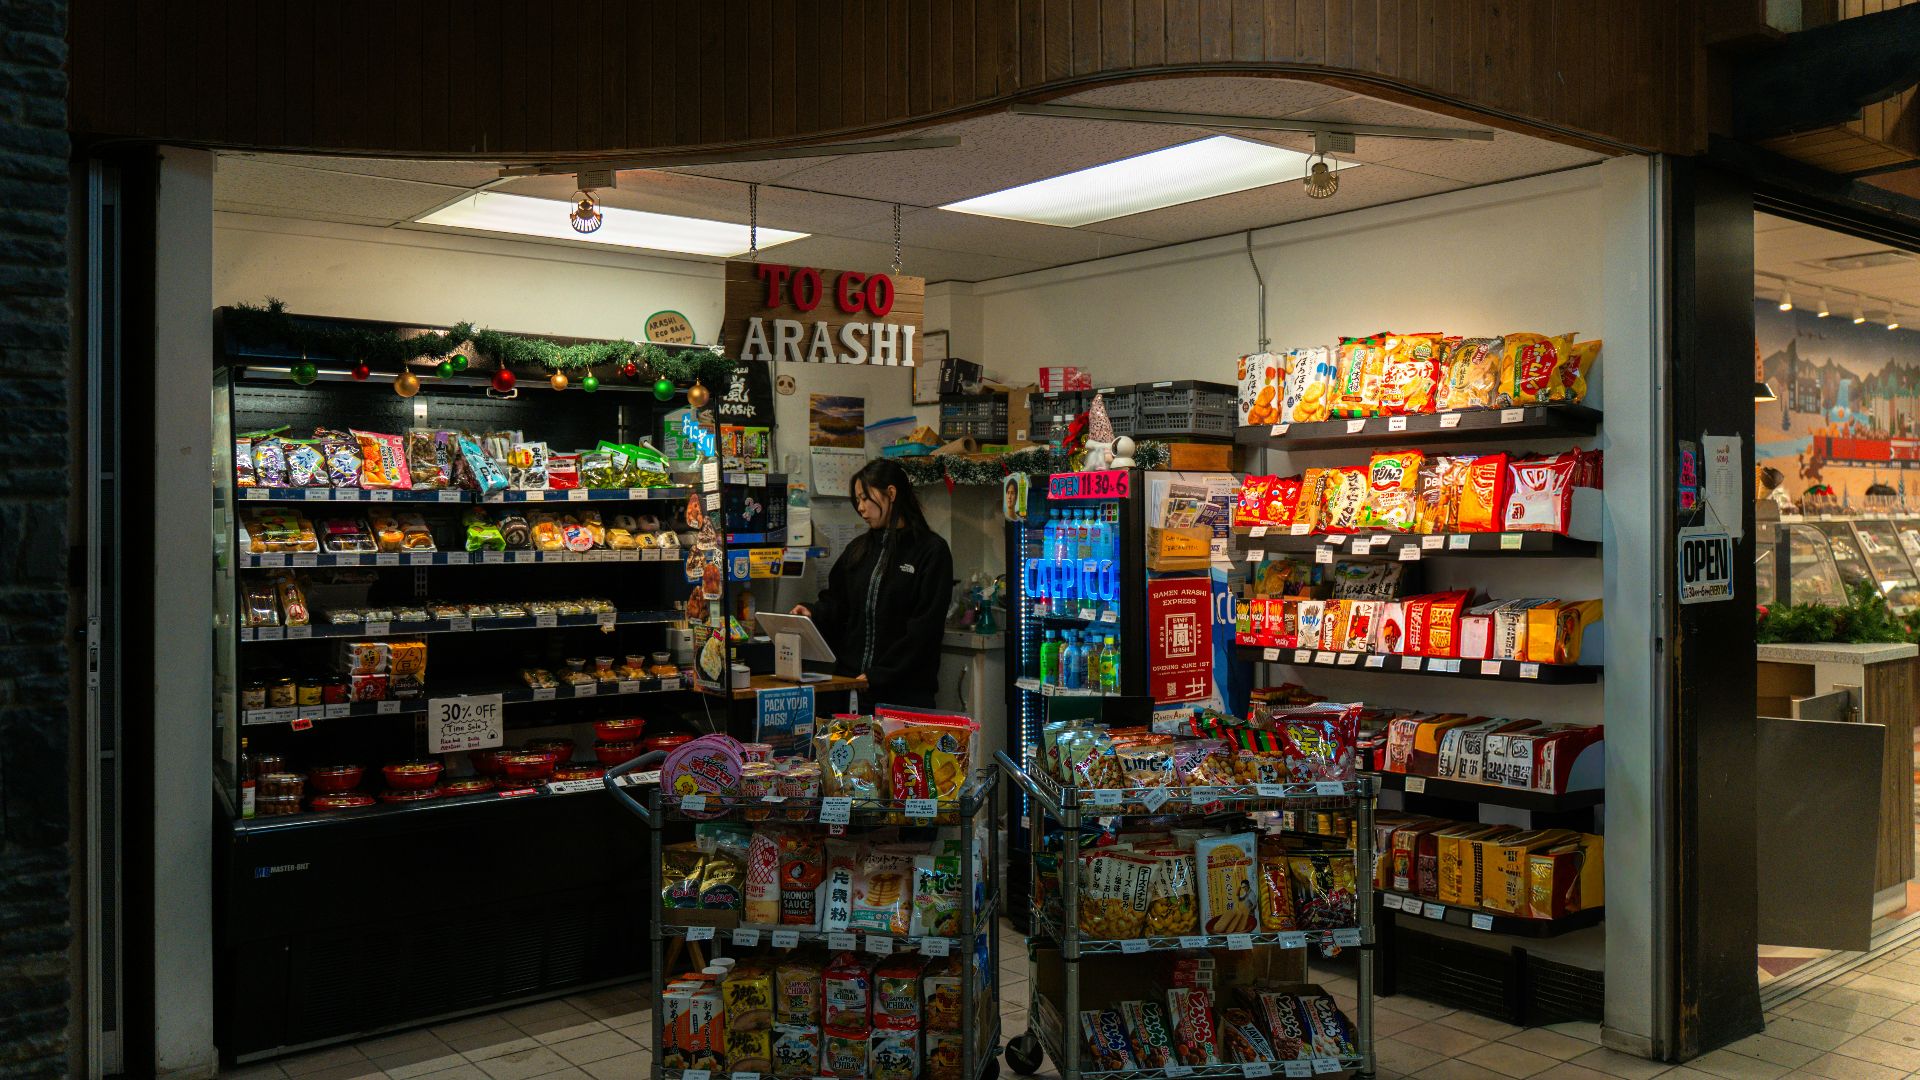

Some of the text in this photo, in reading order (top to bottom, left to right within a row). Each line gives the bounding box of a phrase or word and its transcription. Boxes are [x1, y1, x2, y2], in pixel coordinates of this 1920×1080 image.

[758, 263, 895, 317] TO GO
[650, 317, 676, 330] ARASHI
[655, 324, 686, 338] ECO BAG
[740, 316, 916, 367] ARASHI
[1384, 361, 1433, 383] ばかうけ
[682, 414, 714, 455] おにぎり
[1051, 475, 1080, 497] OPEN
[1081, 473, 1110, 496] 11:30
[1101, 508, 1118, 517] JCB
[1684, 538, 1729, 584] OPEN
[1024, 558, 1115, 601] CALPICO
[1153, 588, 1208, 599] RAMEN ARASHI
[1162, 598, 1197, 606] EXPRESS
[1152, 663, 1179, 672] OPENING
[1181, 662, 1197, 670] JUNE
[441, 703, 497, 722] 30% OFF
[764, 696, 808, 713] PACK YOUR
[764, 712, 788, 727] BAGS!
[1153, 711, 1173, 722] RAMEN
[446, 722, 481, 733] Time Sale
[864, 854, 914, 864] ホットケーキ
[1135, 868, 1150, 911] チーズスナック
[784, 899, 810, 909] SAUCE
[1245, 1024, 1263, 1045] JAVA
